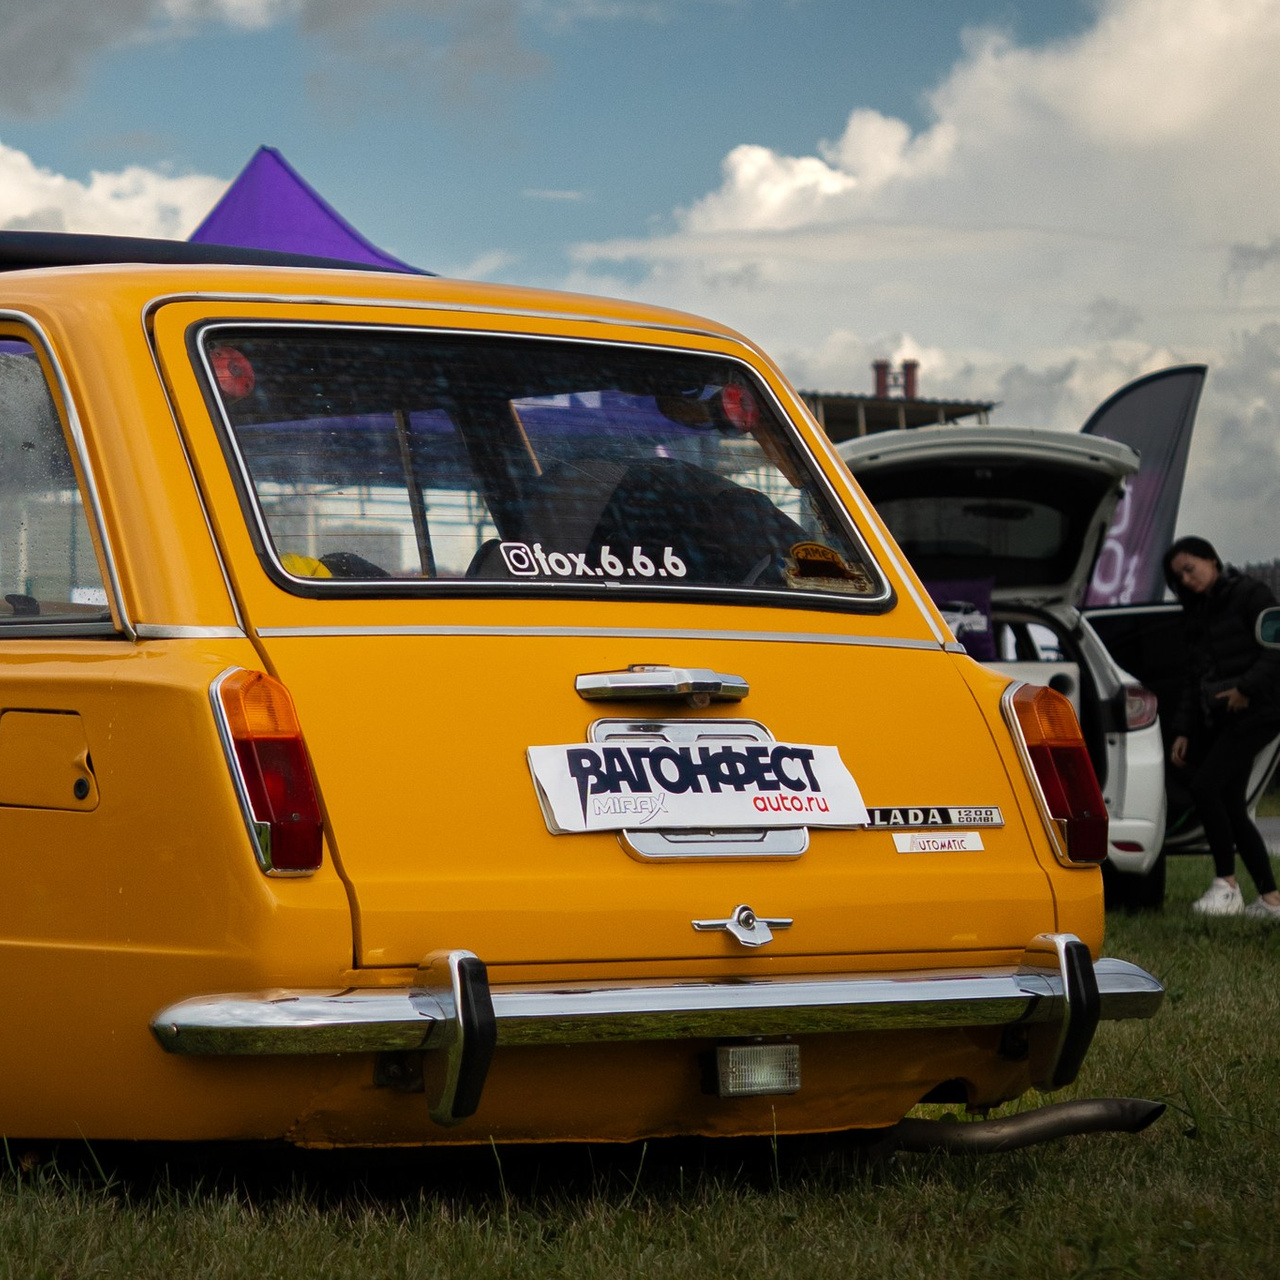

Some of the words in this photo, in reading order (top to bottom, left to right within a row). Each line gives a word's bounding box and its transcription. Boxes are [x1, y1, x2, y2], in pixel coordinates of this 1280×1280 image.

[533, 543, 687, 577] fox.6.6.6
[566, 746, 822, 828] ВАГОНФЕСТ
[593, 792, 668, 824] MIRAX
[752, 793, 830, 813] auto.ru
[957, 809, 994, 817] 1200
[874, 809, 943, 825] LADA
[908, 834, 968, 851] AUTOMATIC
